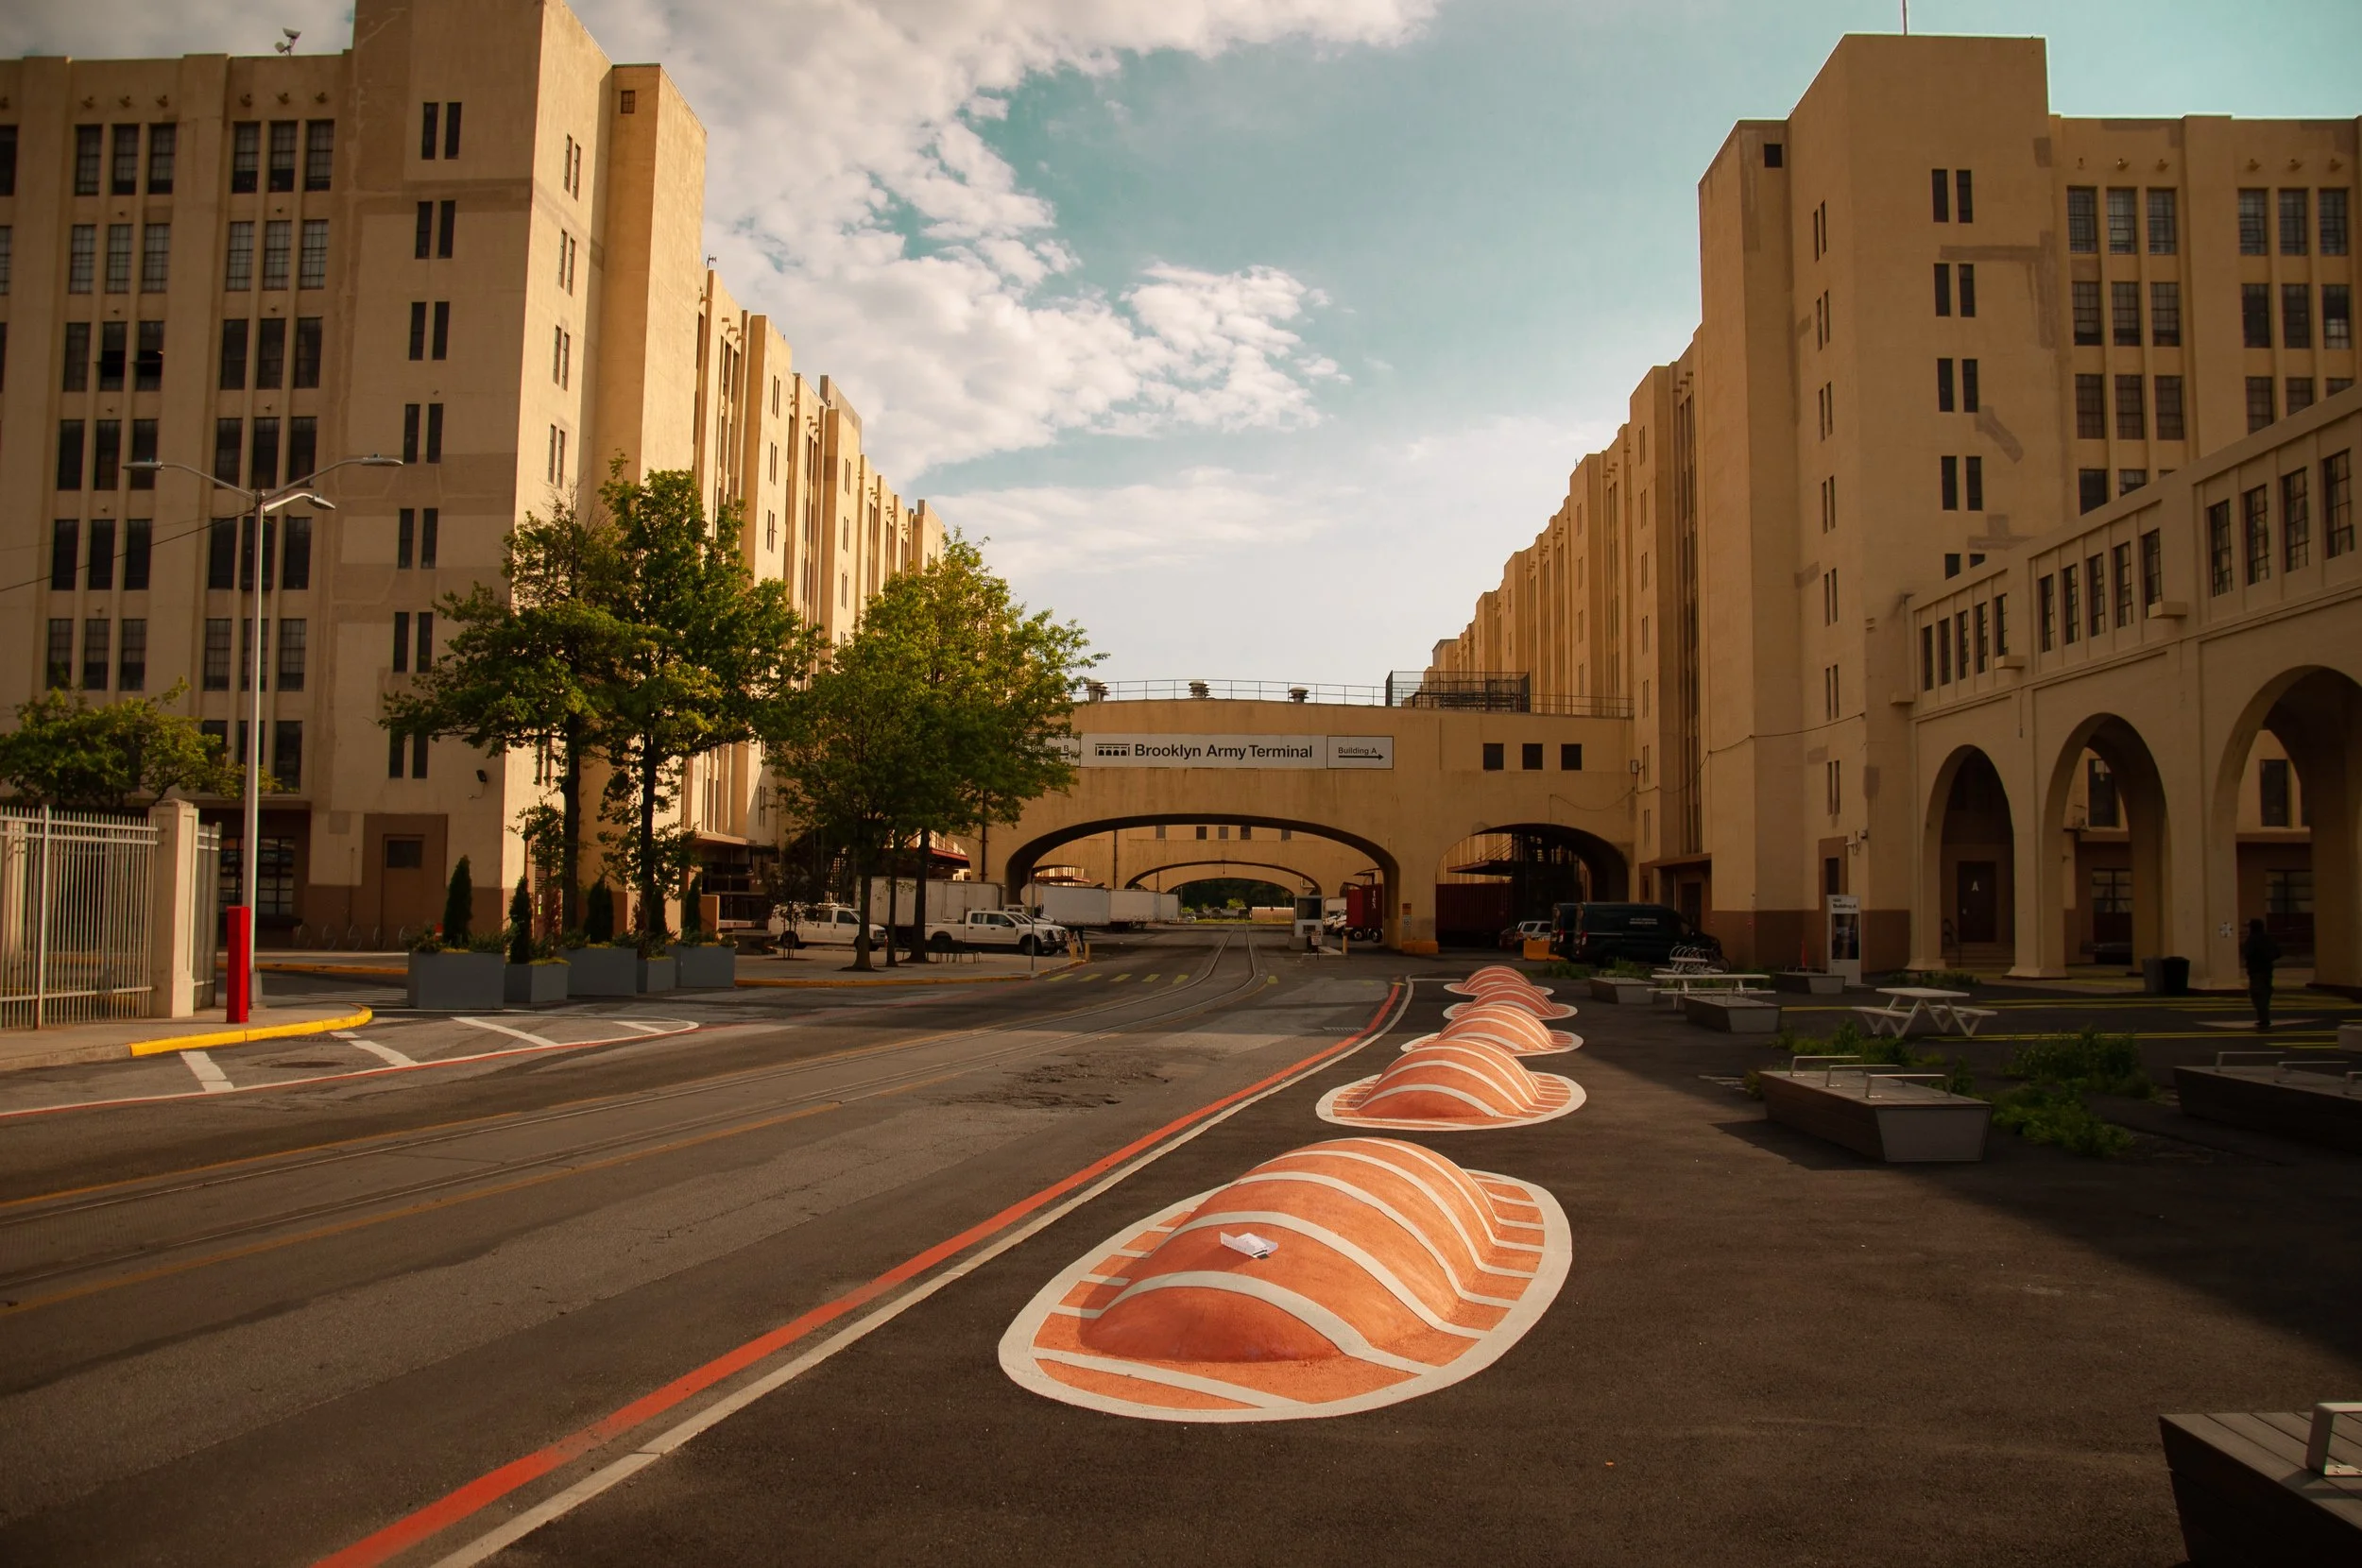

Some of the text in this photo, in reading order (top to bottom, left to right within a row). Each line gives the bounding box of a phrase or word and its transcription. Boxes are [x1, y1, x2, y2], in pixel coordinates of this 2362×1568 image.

[1135, 743, 1312, 760] Brooklyn Army Terminal
[1338, 746, 1369, 756] Building
[1971, 879, 1980, 892] A
